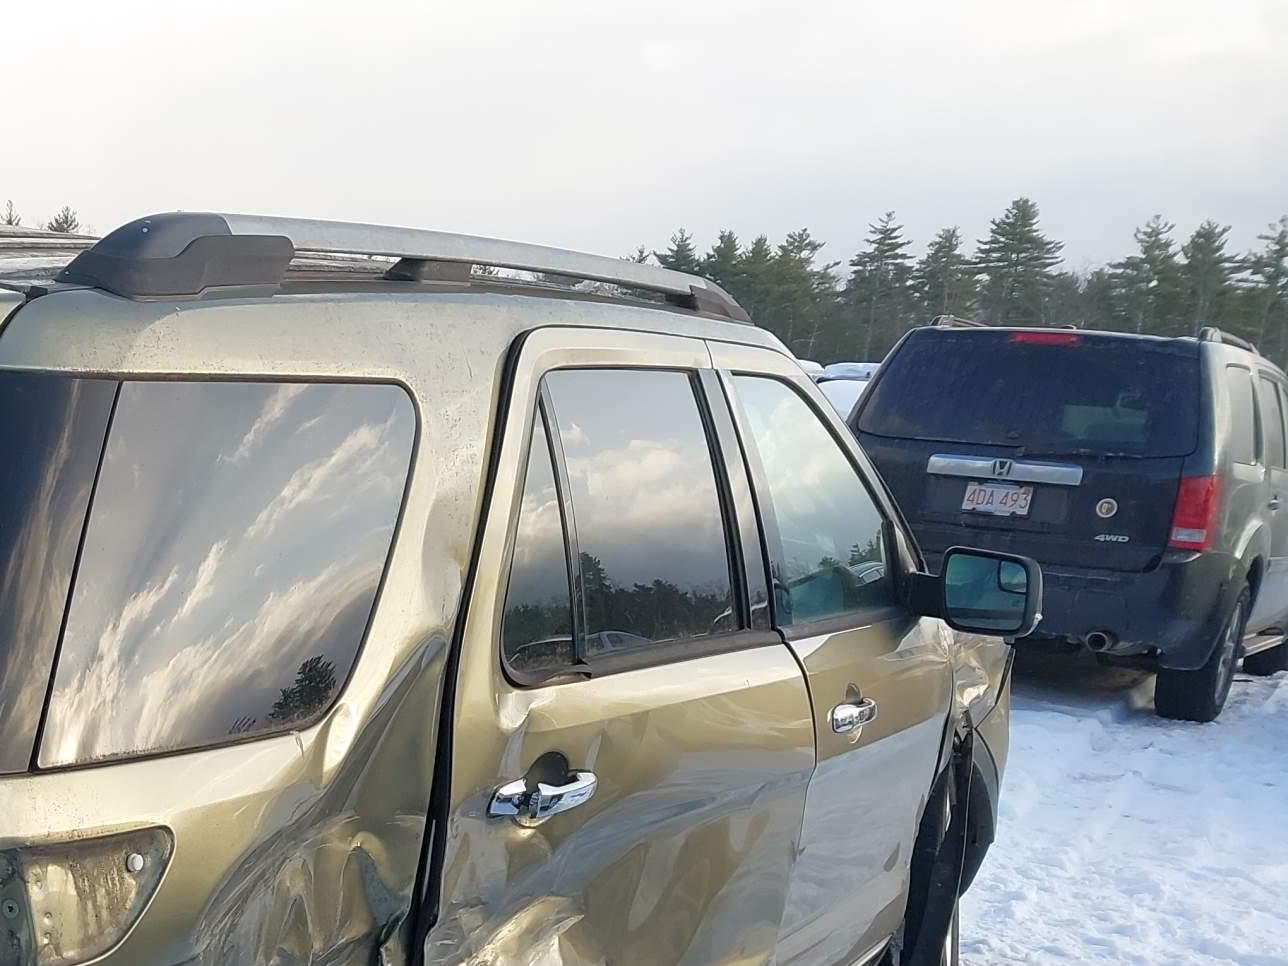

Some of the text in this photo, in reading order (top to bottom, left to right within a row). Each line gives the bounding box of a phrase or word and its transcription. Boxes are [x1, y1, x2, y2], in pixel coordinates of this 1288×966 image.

[966, 487, 1030, 510] 4DA 493
[1093, 534, 1130, 543] 4WD
